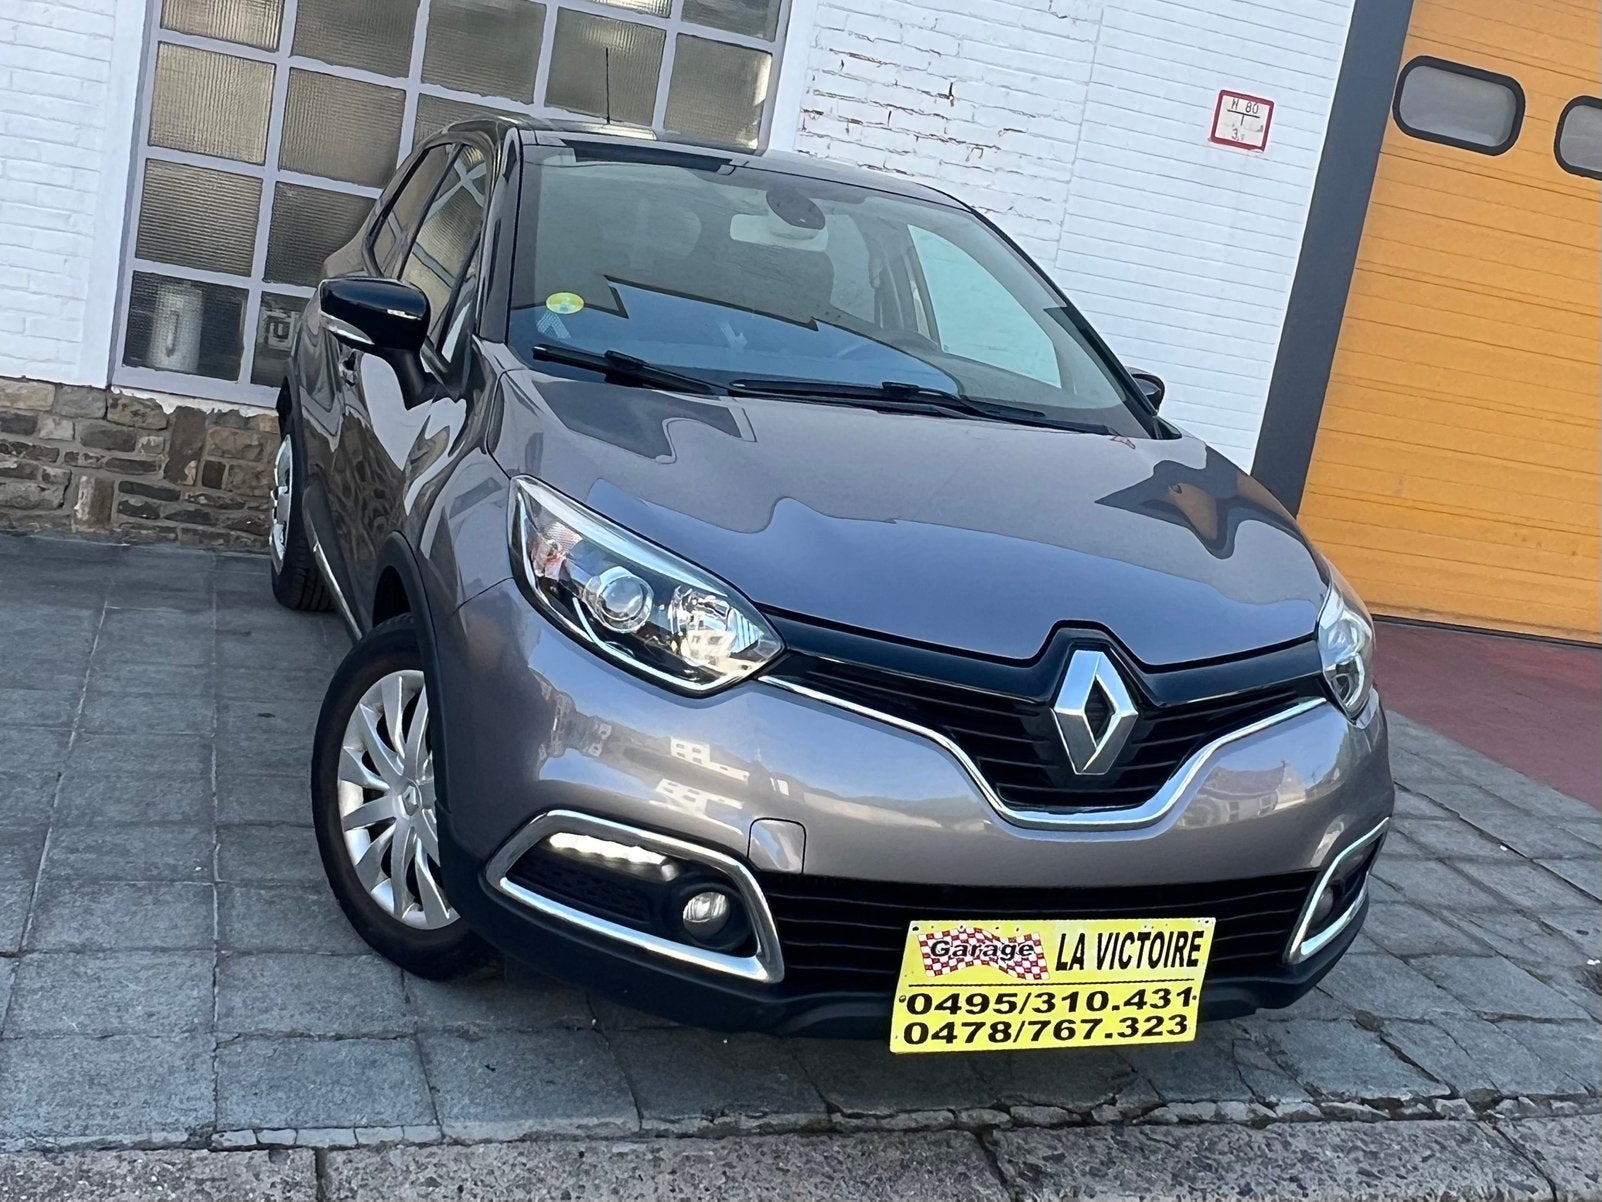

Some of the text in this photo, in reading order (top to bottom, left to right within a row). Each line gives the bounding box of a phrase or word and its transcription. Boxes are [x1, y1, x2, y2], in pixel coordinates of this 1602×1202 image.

[1245, 101, 1259, 114] 80
[930, 930, 1205, 971] Garage LA VICTOIRE
[906, 987, 1193, 1016] 0495/310.431
[903, 1014, 1188, 1045] 0478/767.323
